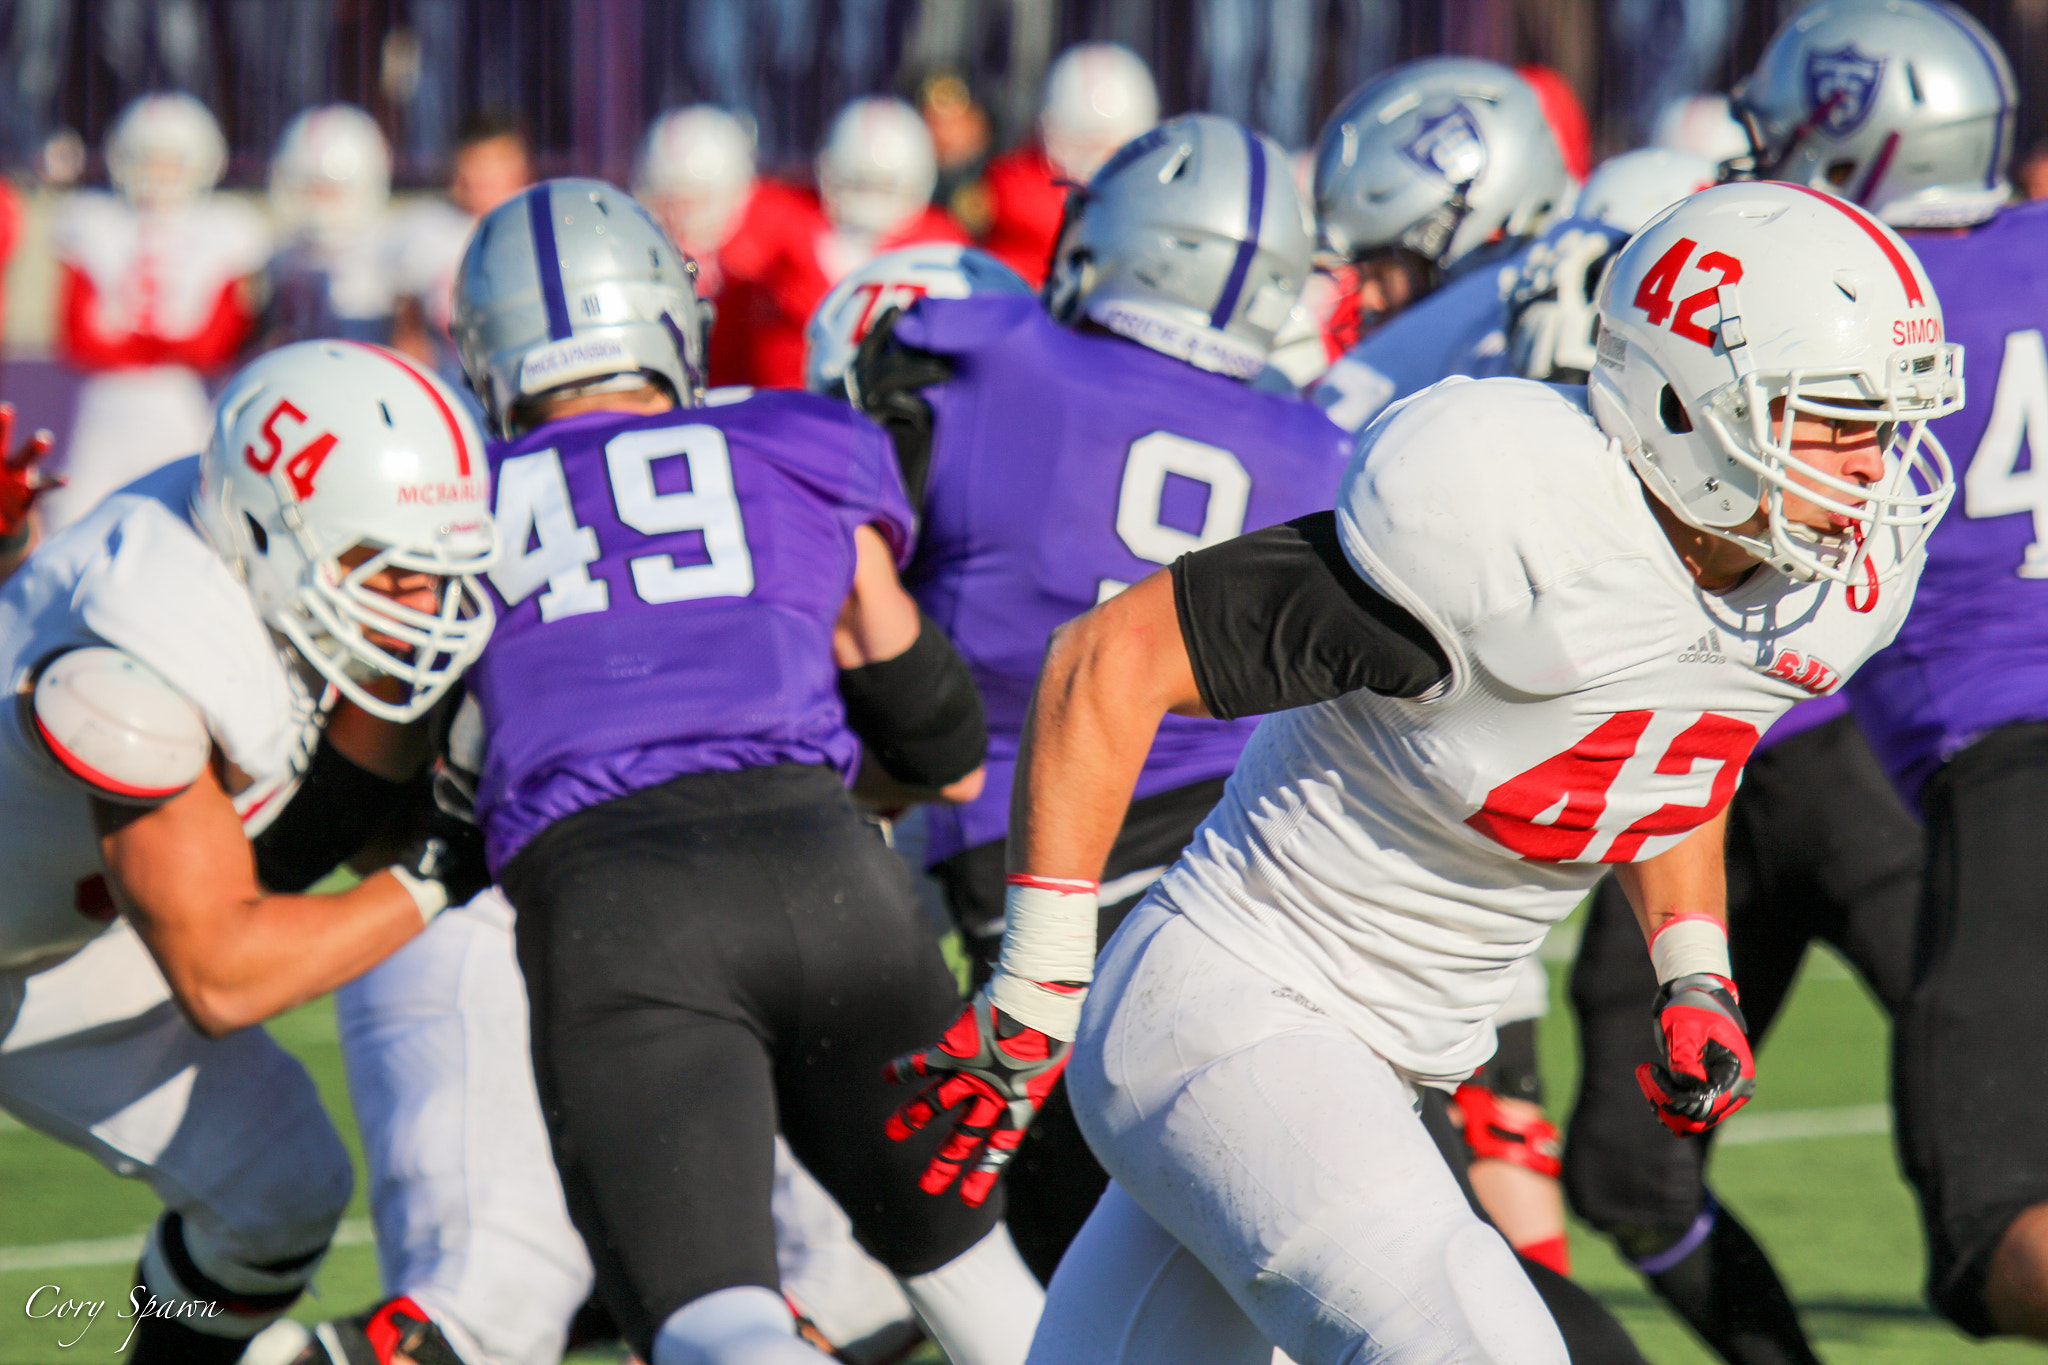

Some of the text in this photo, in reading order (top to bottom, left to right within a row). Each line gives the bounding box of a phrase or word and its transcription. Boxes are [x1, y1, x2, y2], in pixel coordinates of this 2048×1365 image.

[1633, 237, 1744, 348] 42
[244, 399, 339, 502] 54
[487, 422, 755, 624] 49
[1096, 430, 1251, 605] 9
[1677, 650, 1728, 665] adidas
[1763, 649, 1841, 694] SJU
[1463, 709, 1760, 864] 42
